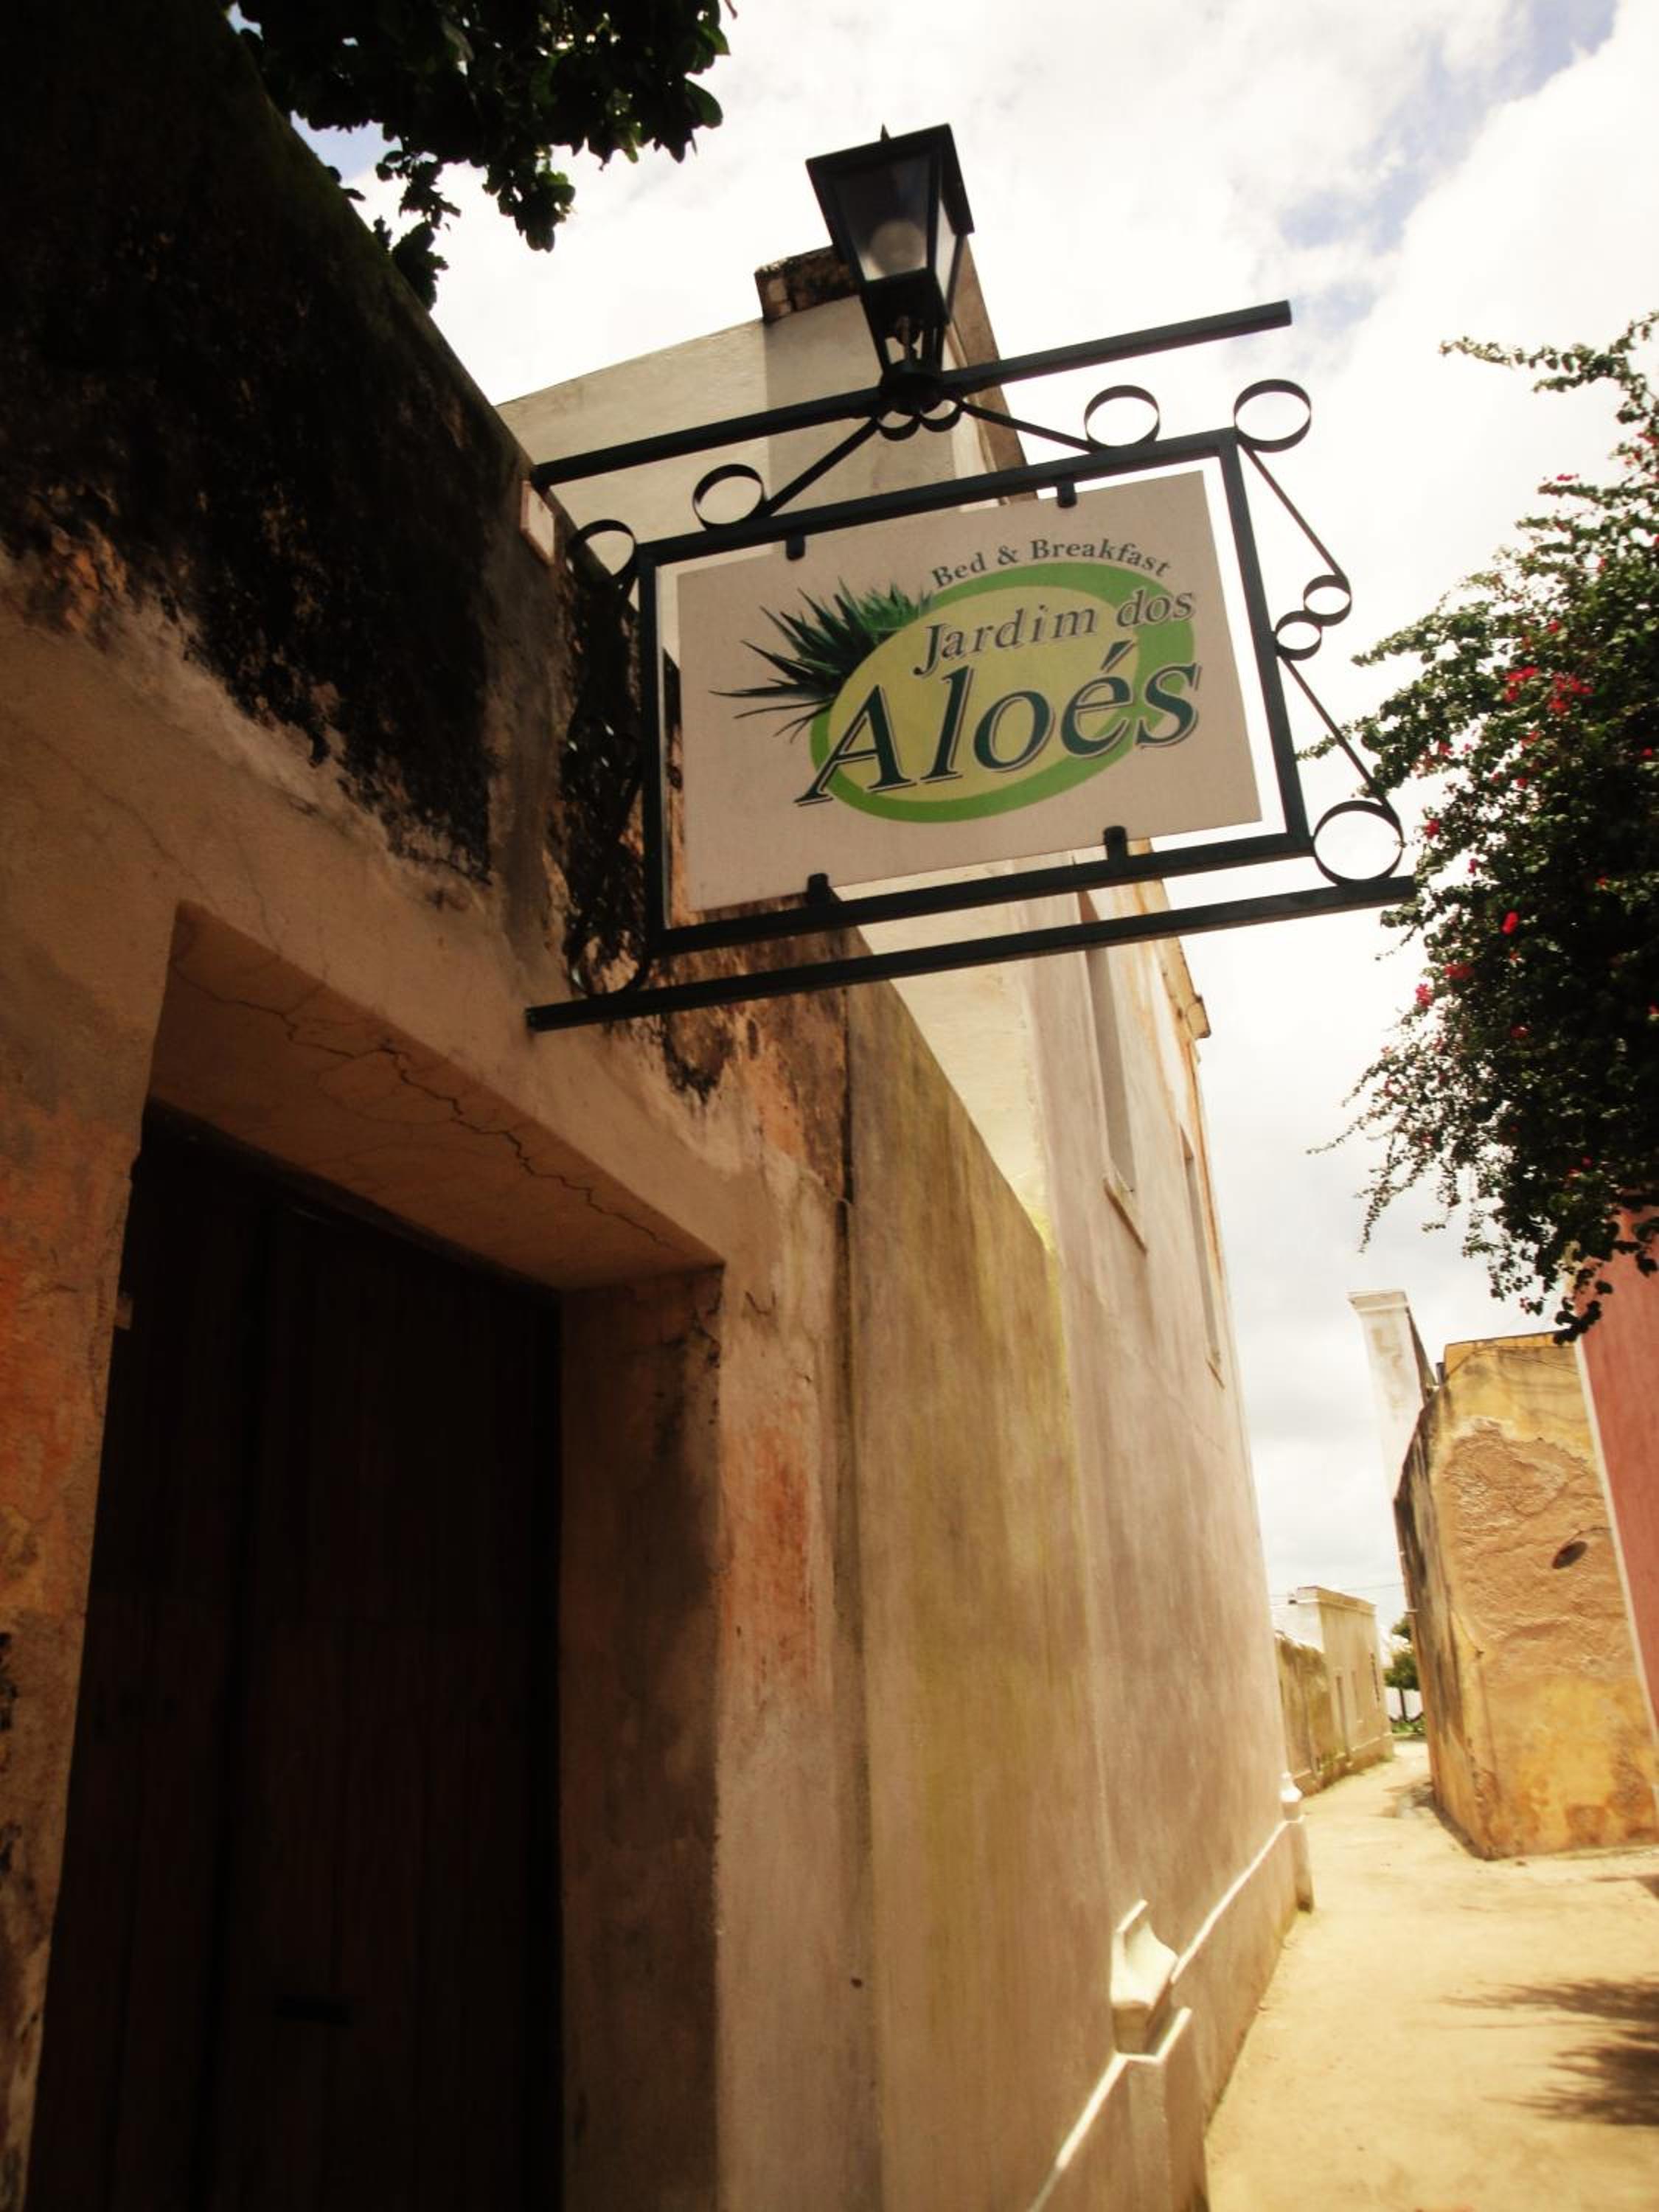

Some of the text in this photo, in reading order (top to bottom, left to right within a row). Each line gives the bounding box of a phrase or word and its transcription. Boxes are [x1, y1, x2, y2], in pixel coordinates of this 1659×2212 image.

[931, 538, 1170, 588] Bed & Breakfast
[913, 588, 1194, 678] Jardim dos
[793, 639, 1202, 807] Aloés
